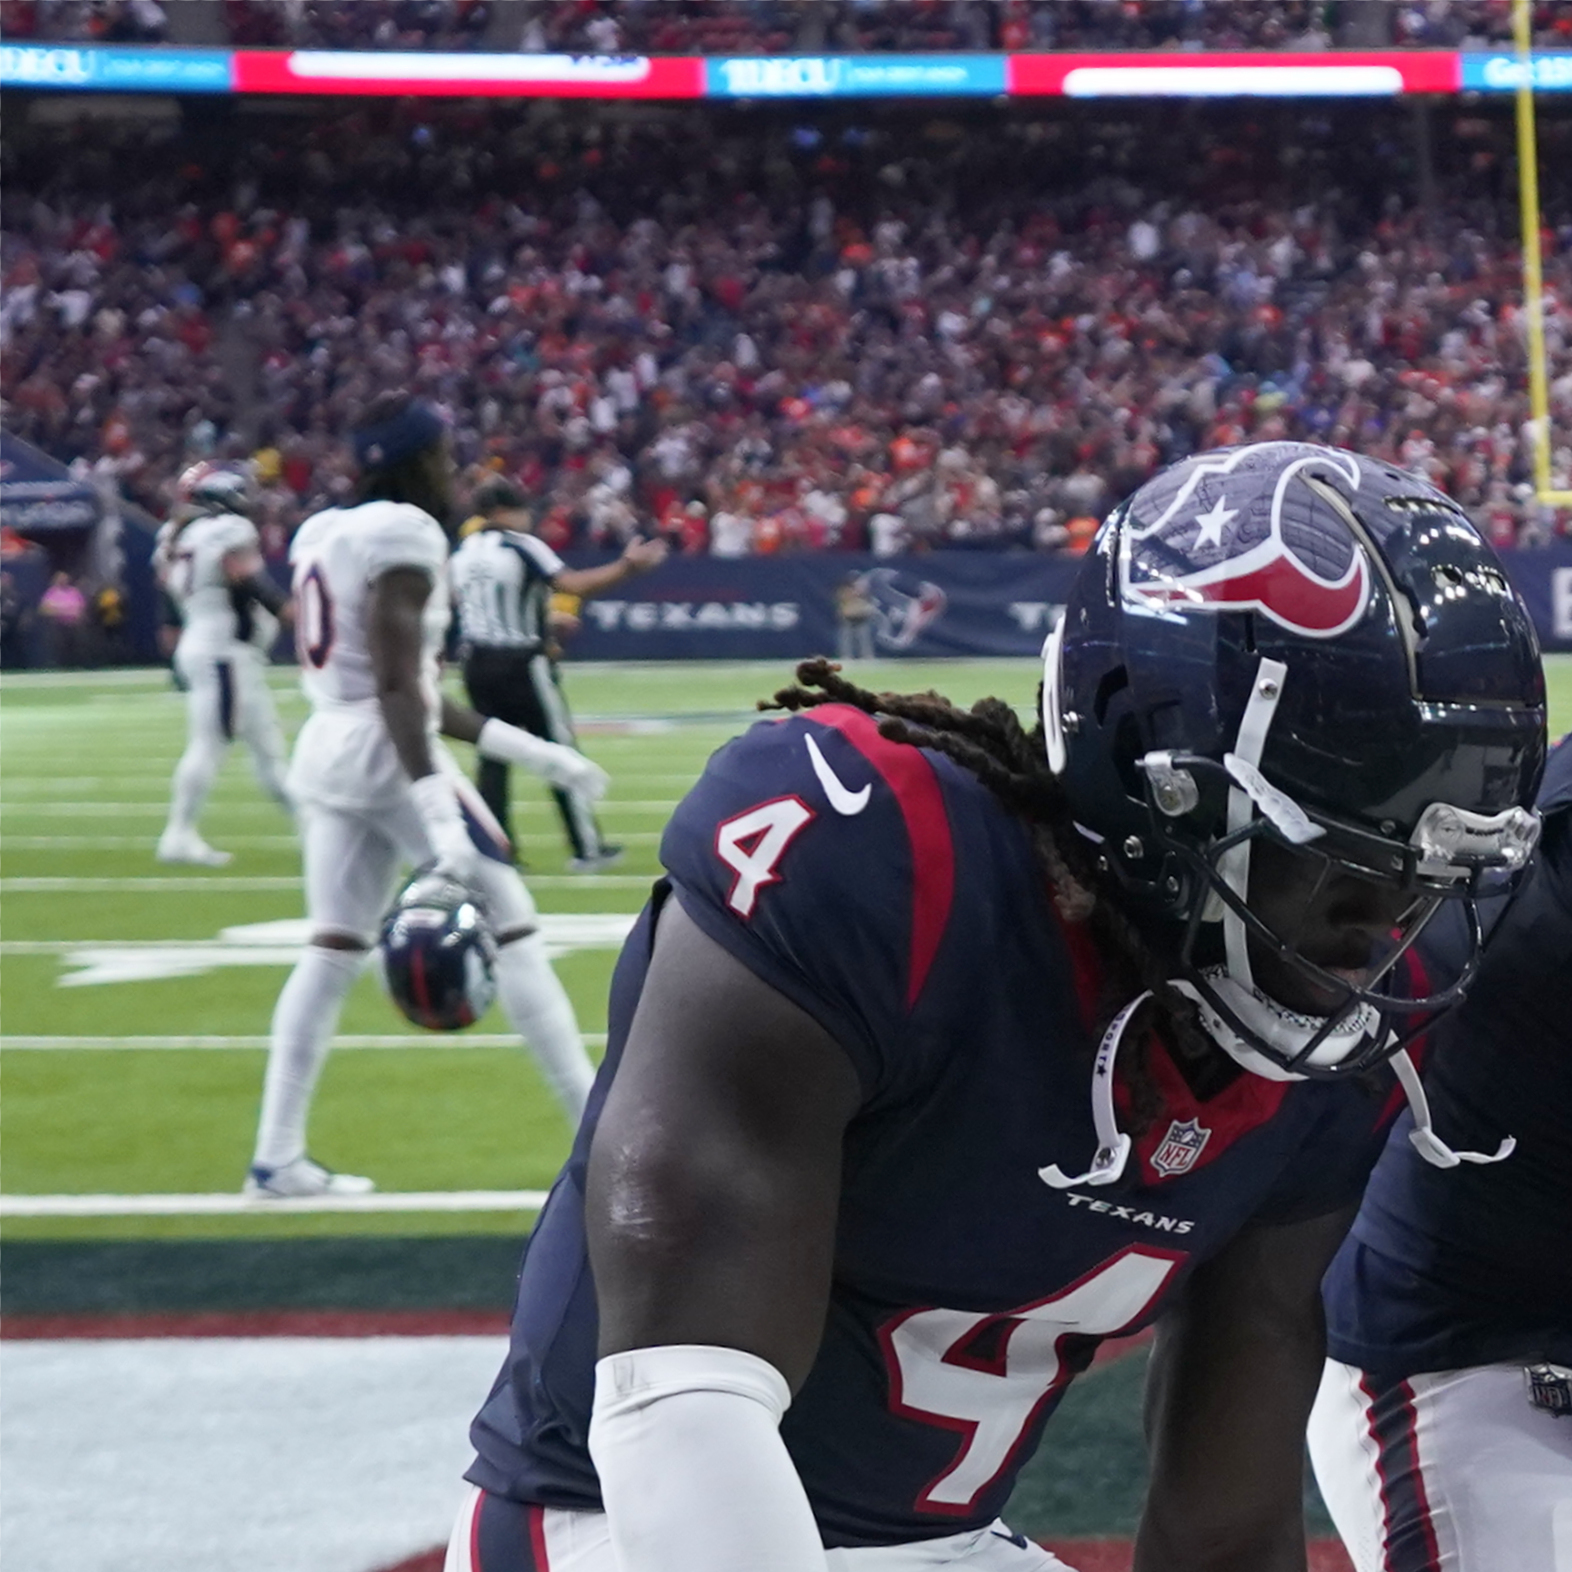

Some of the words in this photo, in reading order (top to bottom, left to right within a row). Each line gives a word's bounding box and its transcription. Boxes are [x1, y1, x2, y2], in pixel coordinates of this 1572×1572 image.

[592, 600, 799, 631] TEXANS
[714, 794, 816, 919] 4
[1160, 1142, 1194, 1168] NFL
[1066, 1192, 1196, 1235] TEXANS
[877, 1241, 1190, 1517] 4
